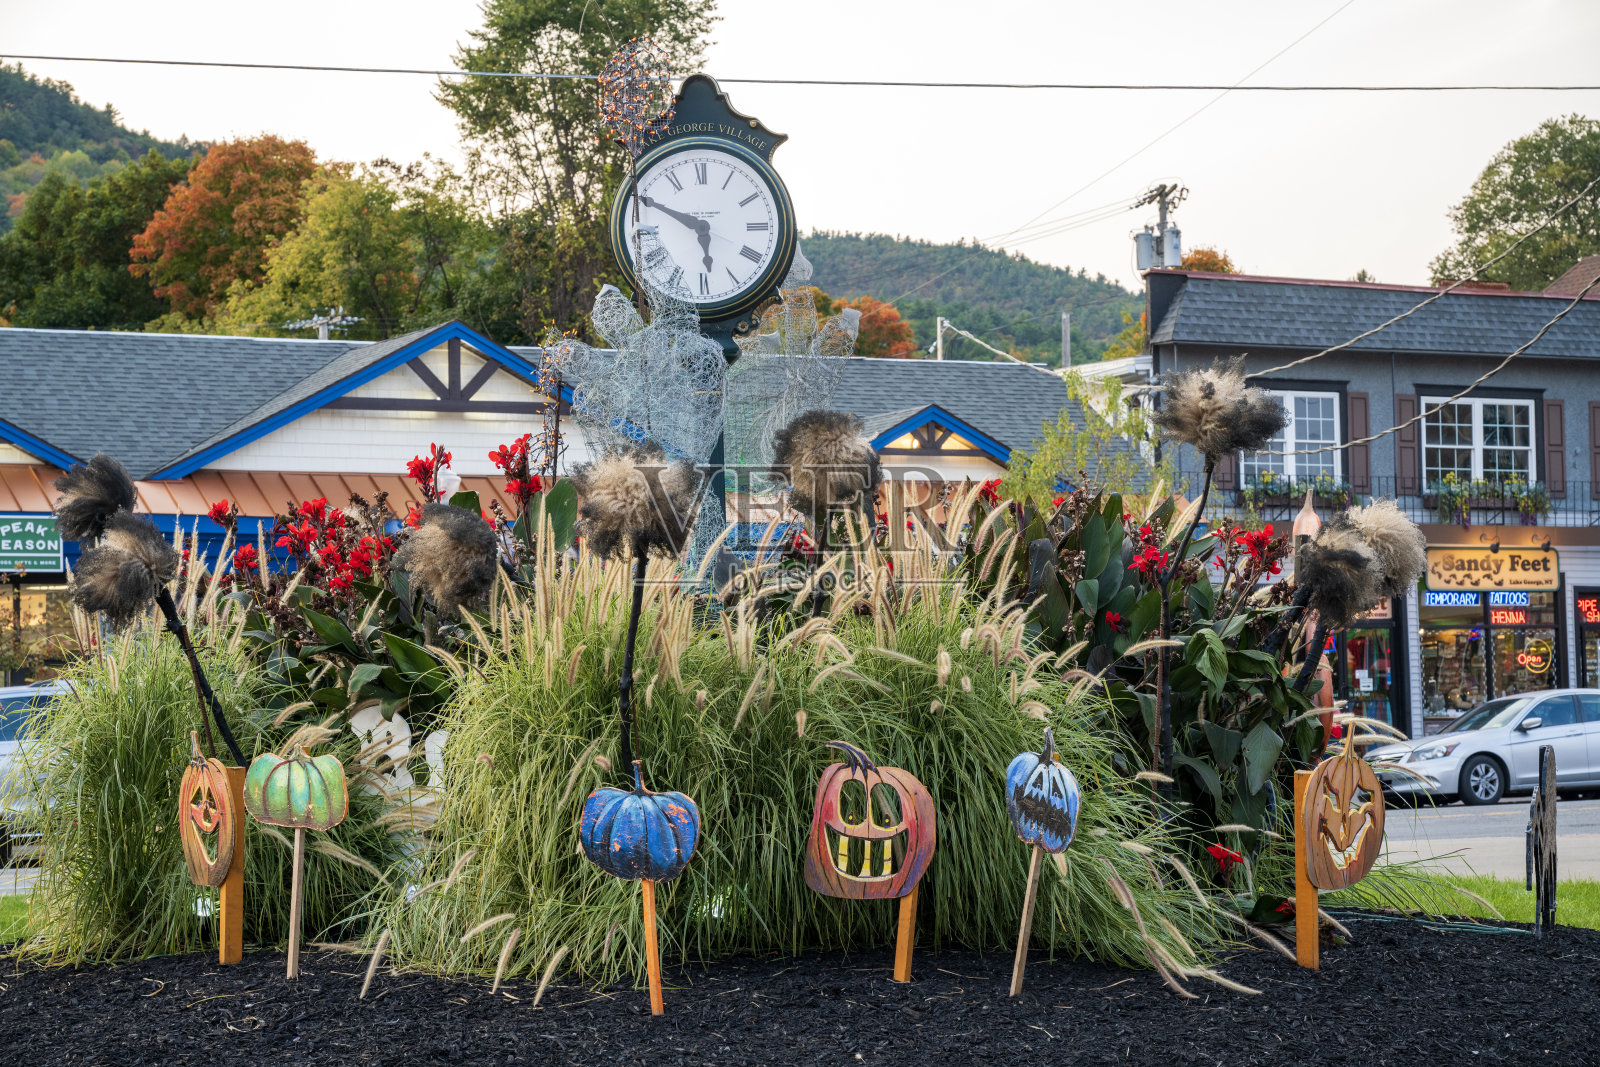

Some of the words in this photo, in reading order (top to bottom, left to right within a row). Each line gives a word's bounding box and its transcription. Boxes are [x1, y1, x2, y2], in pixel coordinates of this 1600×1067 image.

[642, 134, 667, 150] AKE
[667, 122, 715, 136] GEORGE
[719, 124, 767, 151] VILLAGE
[0, 522, 48, 537] PEAK
[1, 540, 58, 550] EASON
[1442, 554, 1504, 575] Sandy
[1509, 554, 1551, 572] Feet
[1425, 592, 1477, 605] TEMPORARY
[1490, 591, 1528, 605] TATTOOS
[1491, 611, 1526, 624] HENNA
[1586, 611, 1600, 623] SH
[1517, 653, 1542, 665] Open
